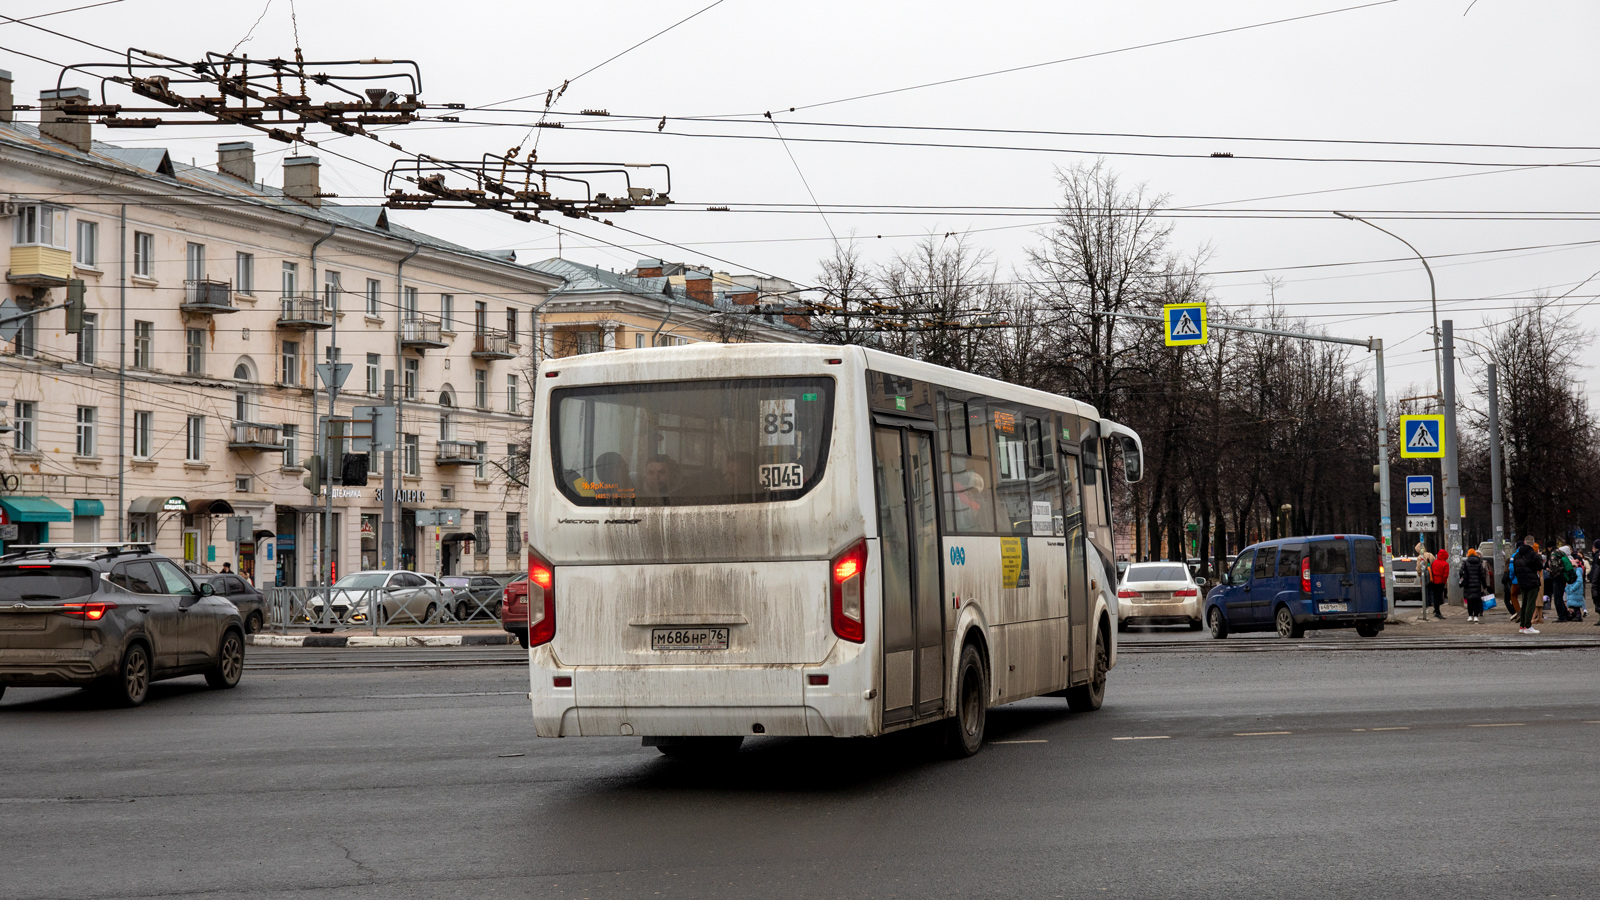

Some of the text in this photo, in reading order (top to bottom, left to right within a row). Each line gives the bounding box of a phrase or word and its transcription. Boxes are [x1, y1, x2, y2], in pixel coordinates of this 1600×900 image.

[764, 413, 793, 434] 85
[762, 466, 801, 487] 3045
[323, 488, 362, 499] ДТЕХНИКА
[375, 488, 425, 503] ЗГАЛЕРЕЯ
[657, 630, 723, 644] М686НР 76
